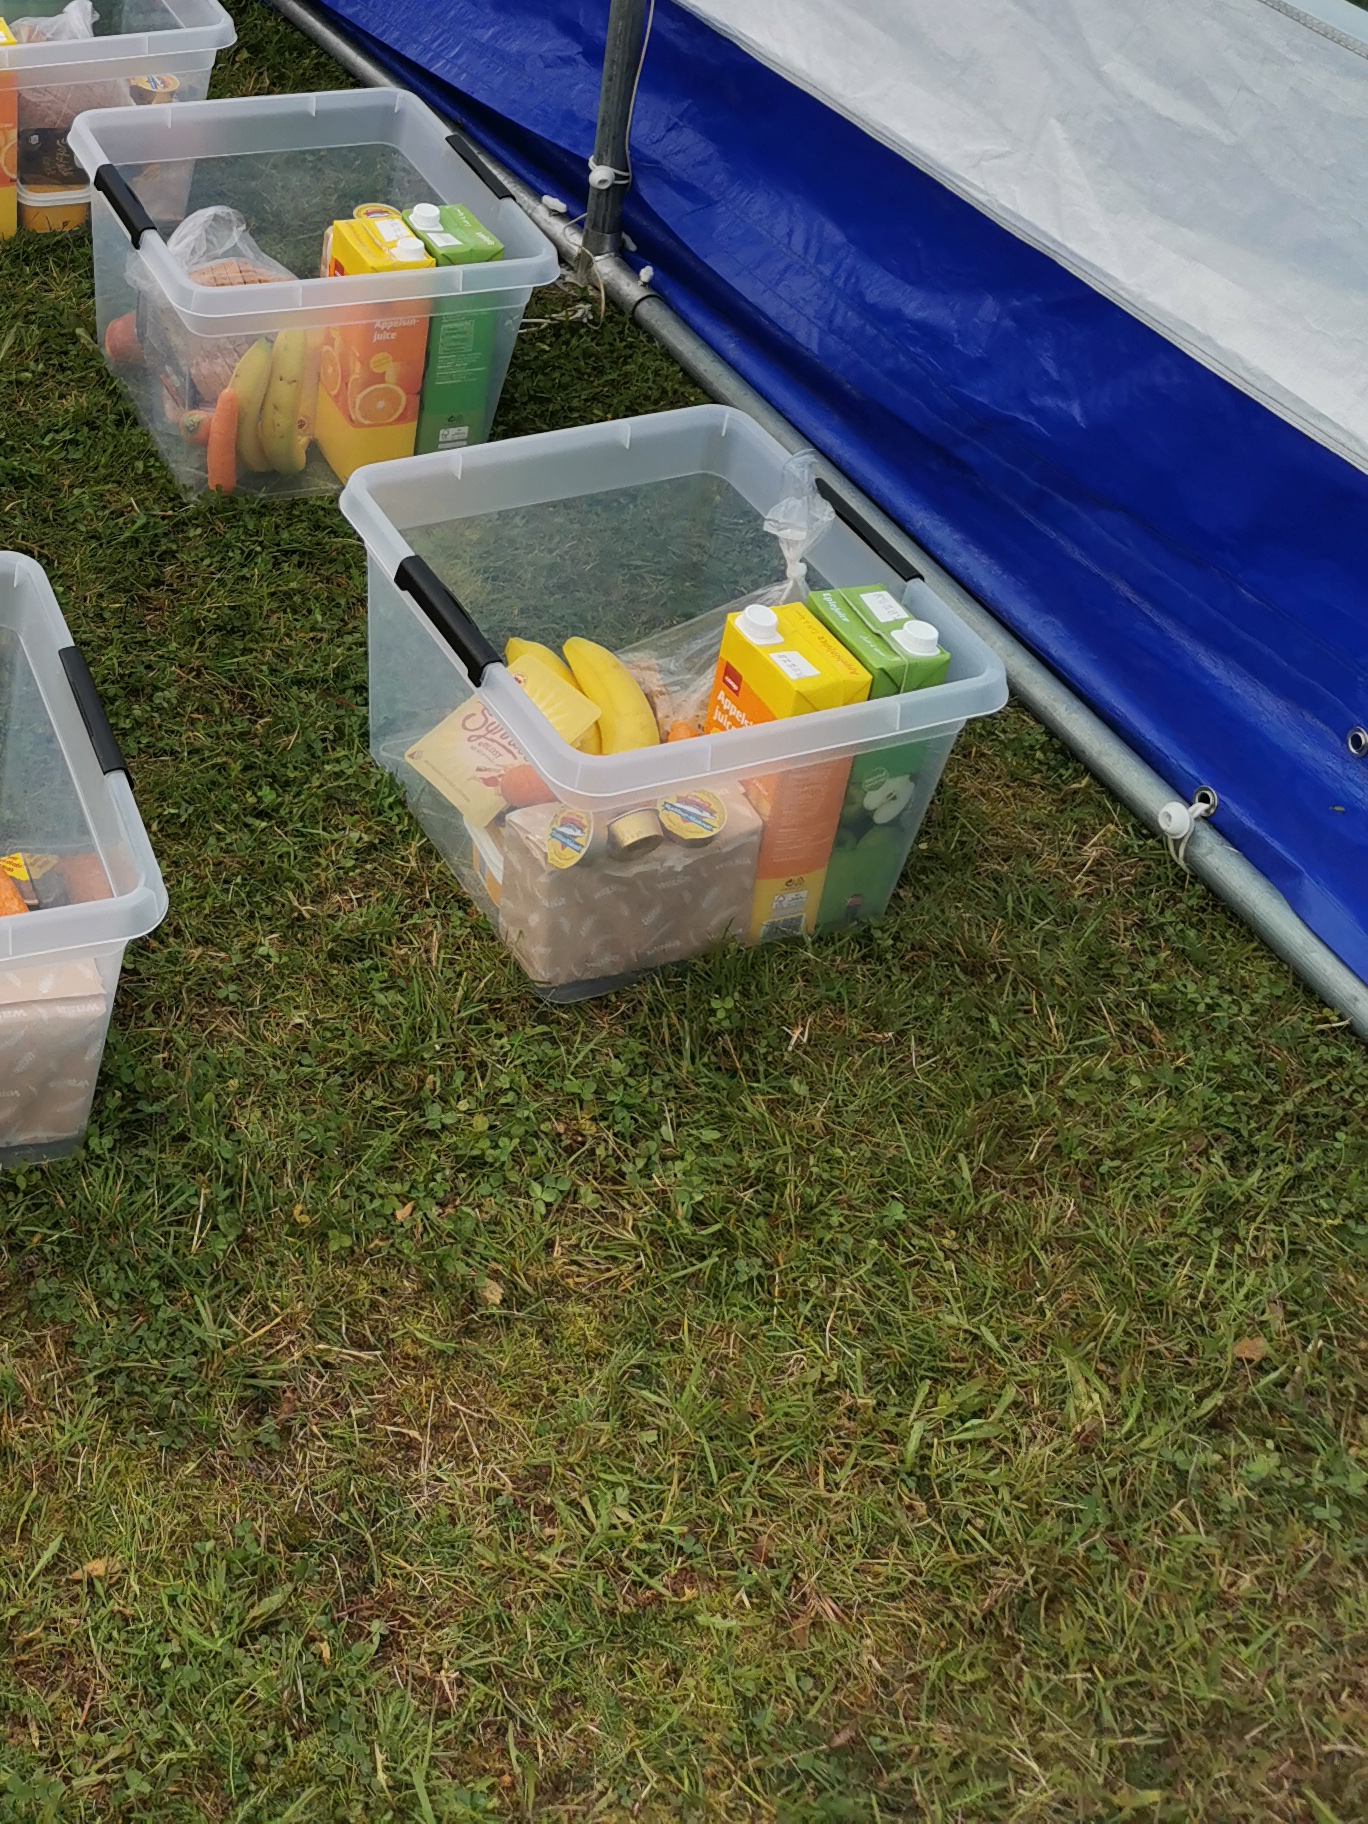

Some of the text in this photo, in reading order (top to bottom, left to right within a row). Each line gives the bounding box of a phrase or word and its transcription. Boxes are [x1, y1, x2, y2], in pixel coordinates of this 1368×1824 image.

[373, 331, 398, 343] juice
[822, 592, 850, 623] Eplejuice
[817, 635, 860, 676] Appelsinjuice
